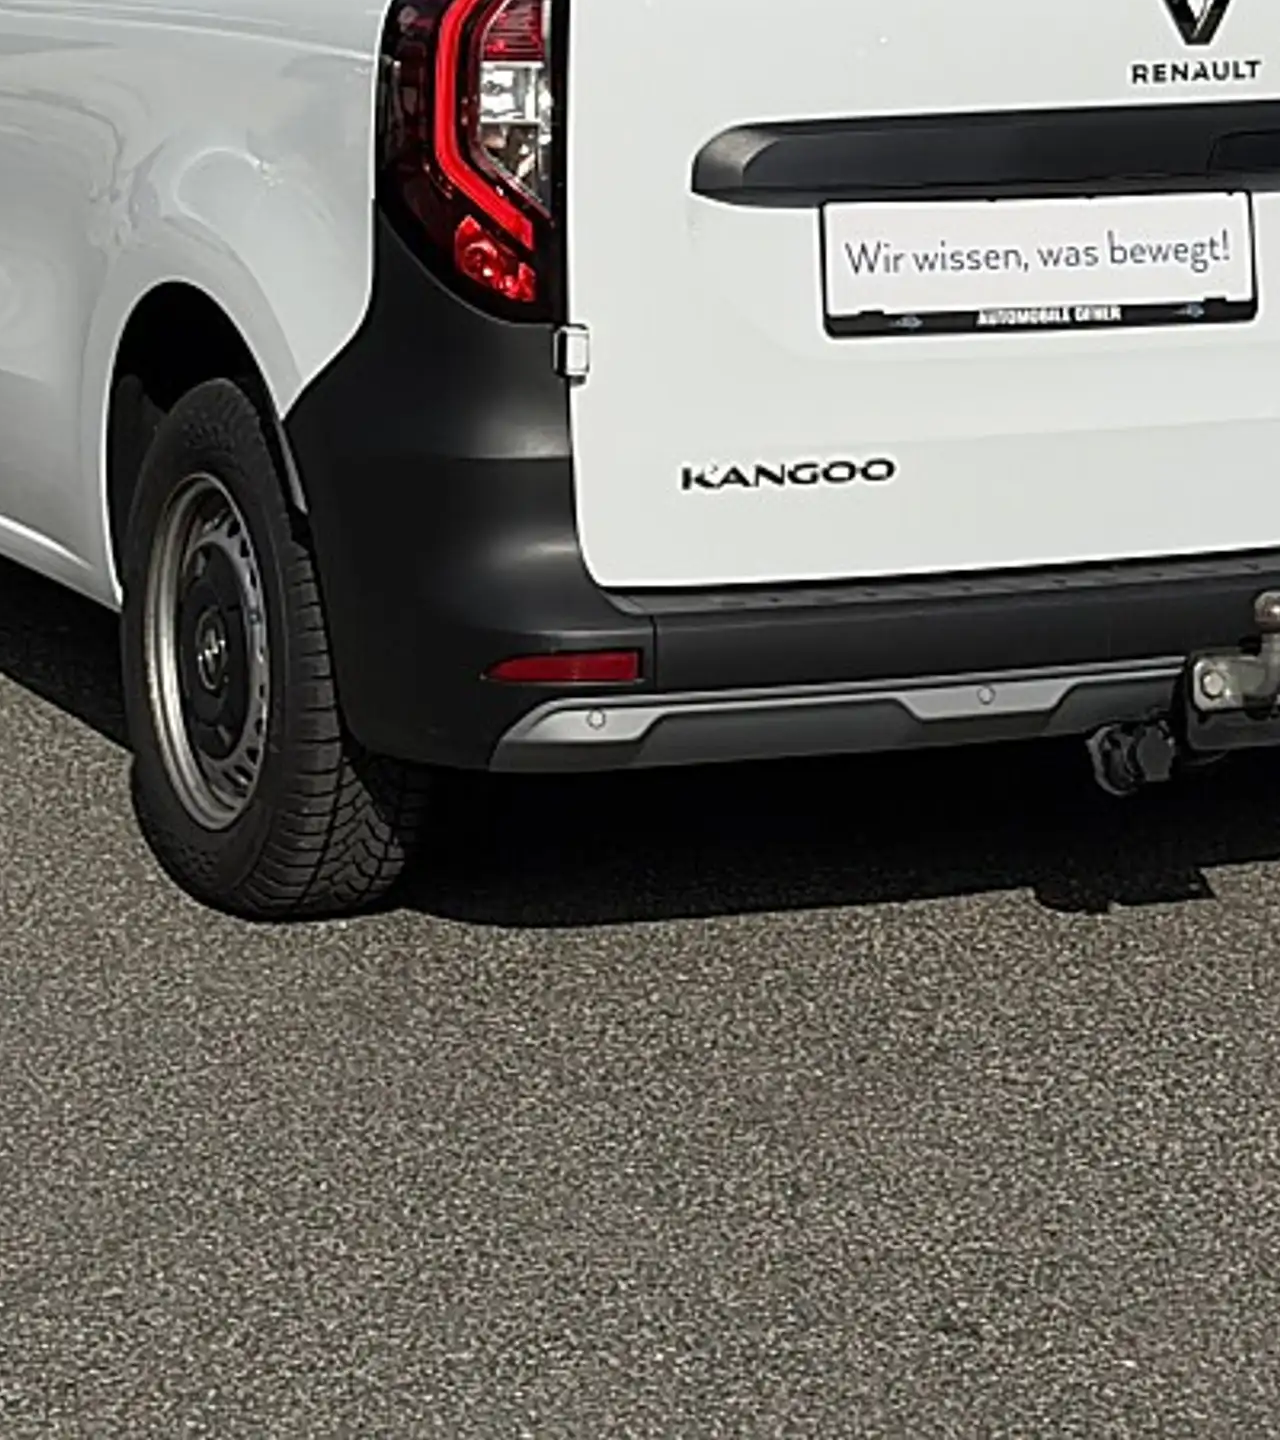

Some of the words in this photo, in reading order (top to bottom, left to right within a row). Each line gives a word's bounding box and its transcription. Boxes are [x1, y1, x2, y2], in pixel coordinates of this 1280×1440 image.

[1131, 59, 1263, 85] RENAULT
[844, 239, 906, 275] Wir
[911, 238, 1030, 273] wissen,
[1036, 245, 1100, 268] was
[1106, 228, 1231, 274] bewegt!
[680, 457, 897, 490] KANGOO
